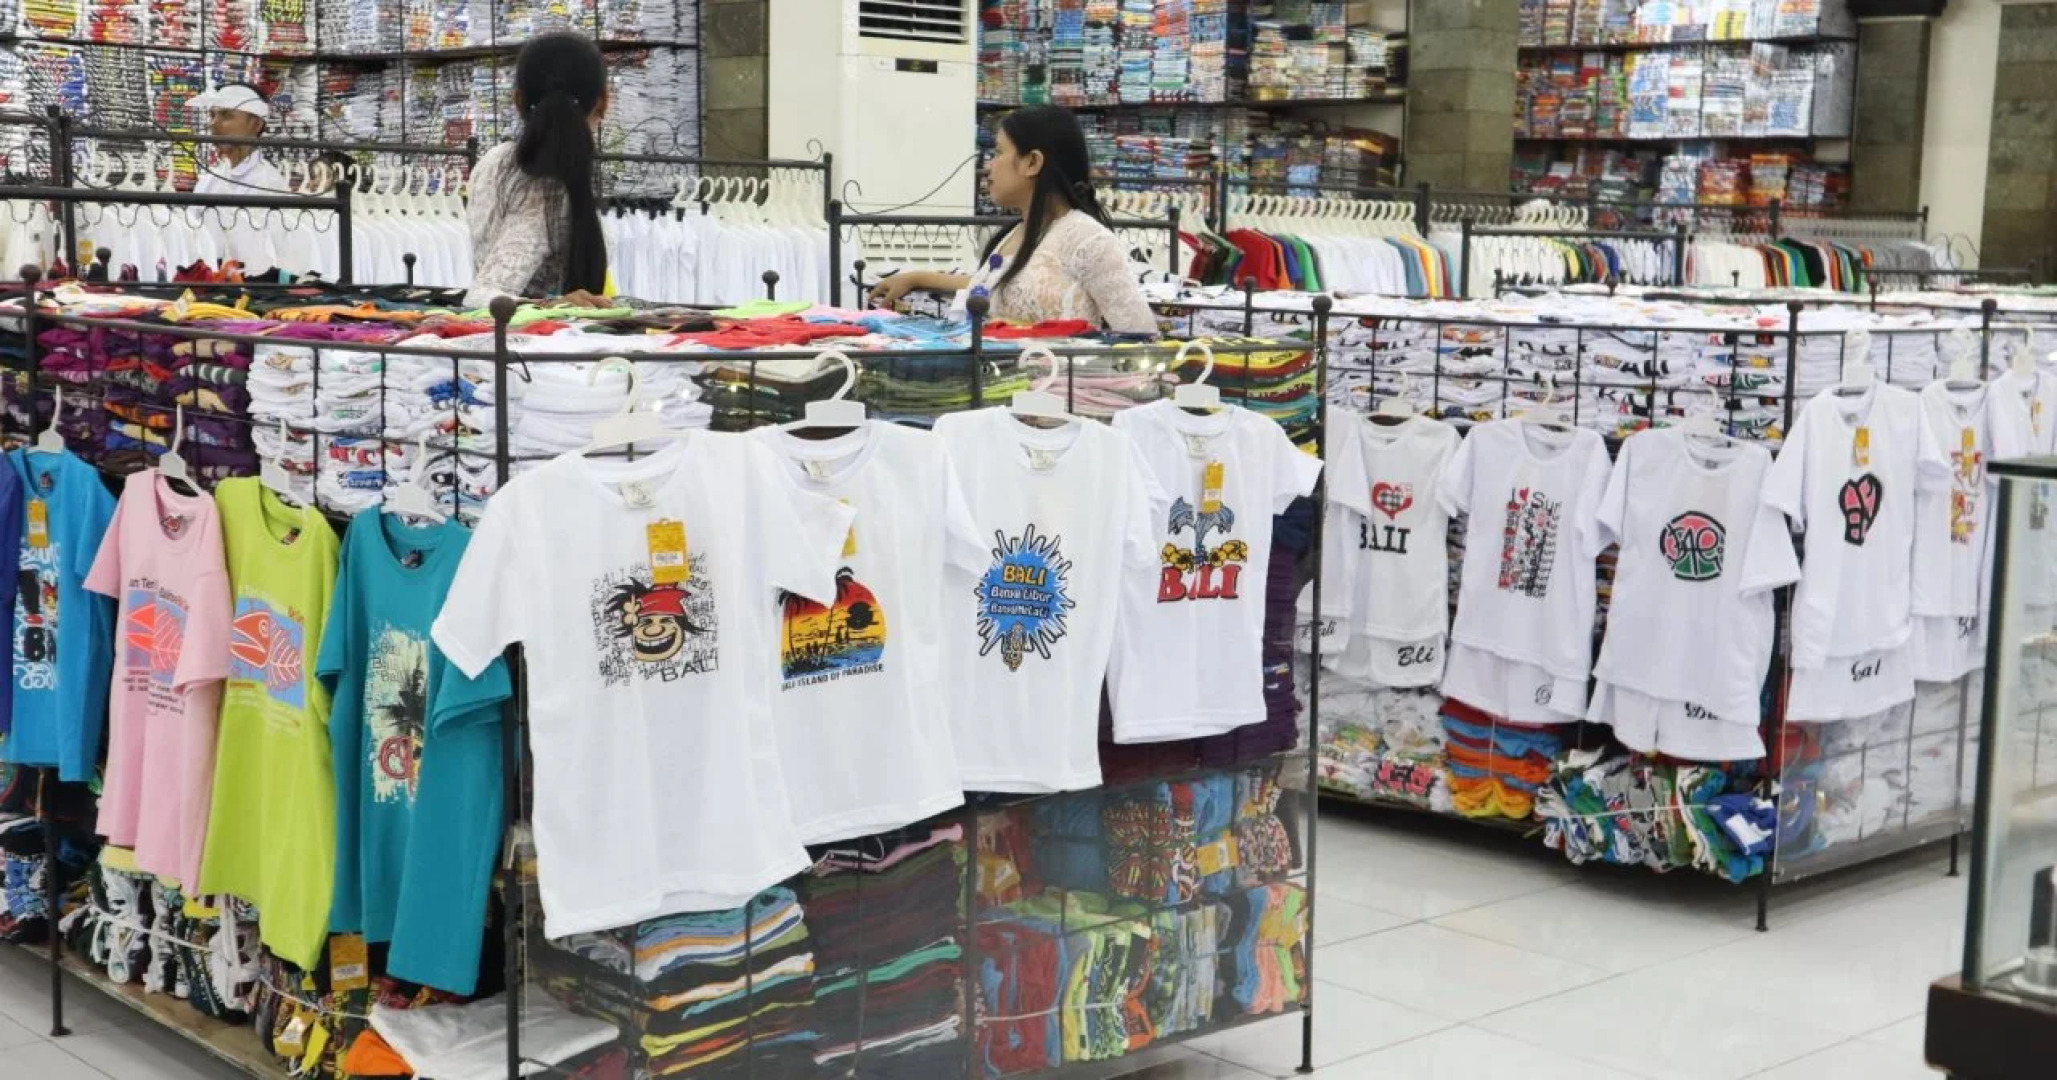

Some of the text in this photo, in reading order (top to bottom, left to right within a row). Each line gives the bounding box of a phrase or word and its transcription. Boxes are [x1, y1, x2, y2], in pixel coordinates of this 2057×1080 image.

[1002, 563, 1047, 587] BALI
[1156, 563, 1243, 604] BLI
[797, 673, 829, 687] ISLAND
[841, 662, 885, 677] PARADISE
